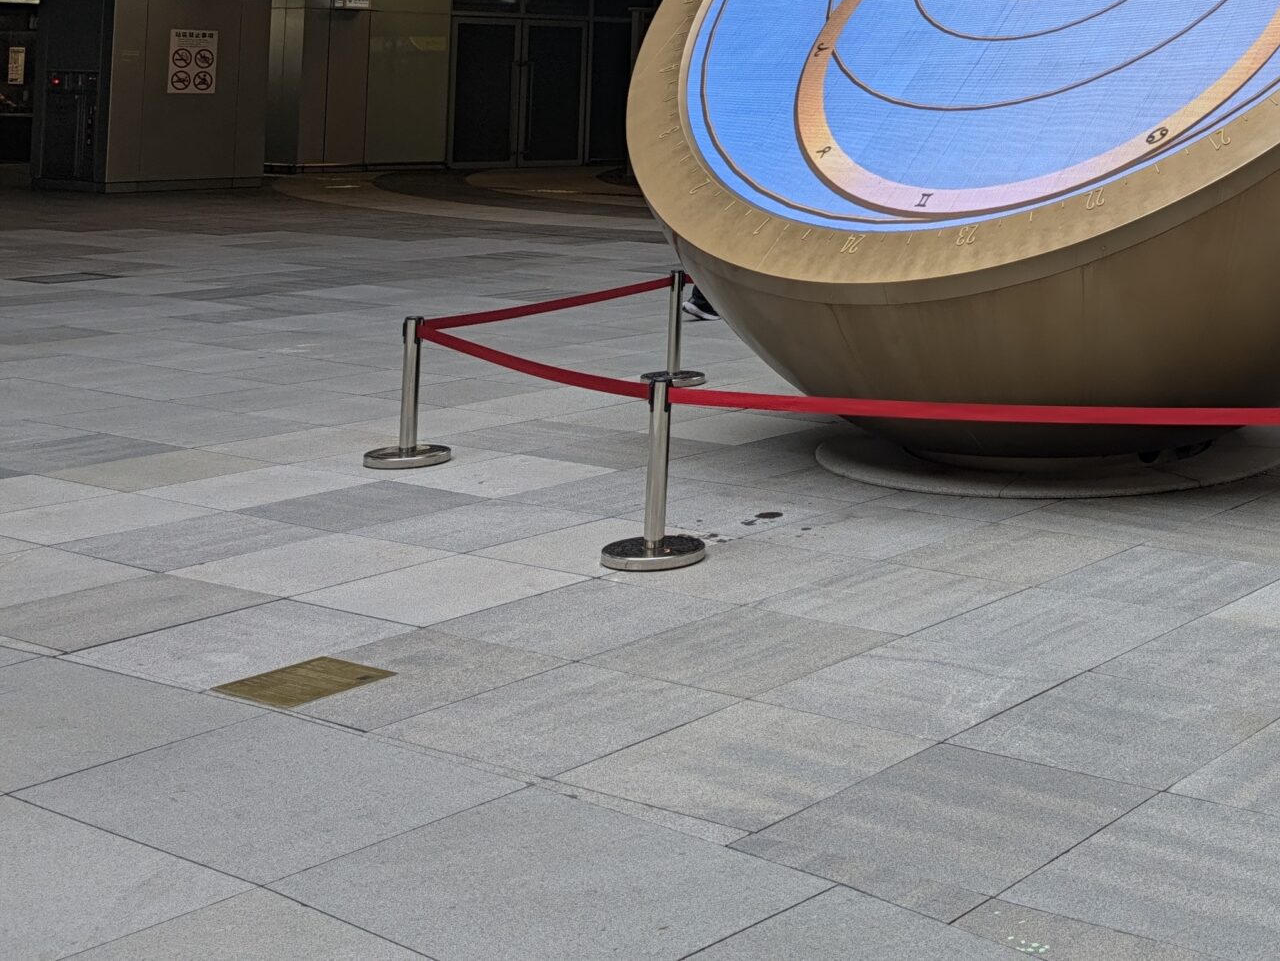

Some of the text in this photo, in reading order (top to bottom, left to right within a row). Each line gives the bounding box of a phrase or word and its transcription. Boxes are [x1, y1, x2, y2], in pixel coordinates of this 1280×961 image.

[1085, 187, 1105, 210] 22
[840, 233, 867, 254] 24
[956, 224, 979, 246] 23
